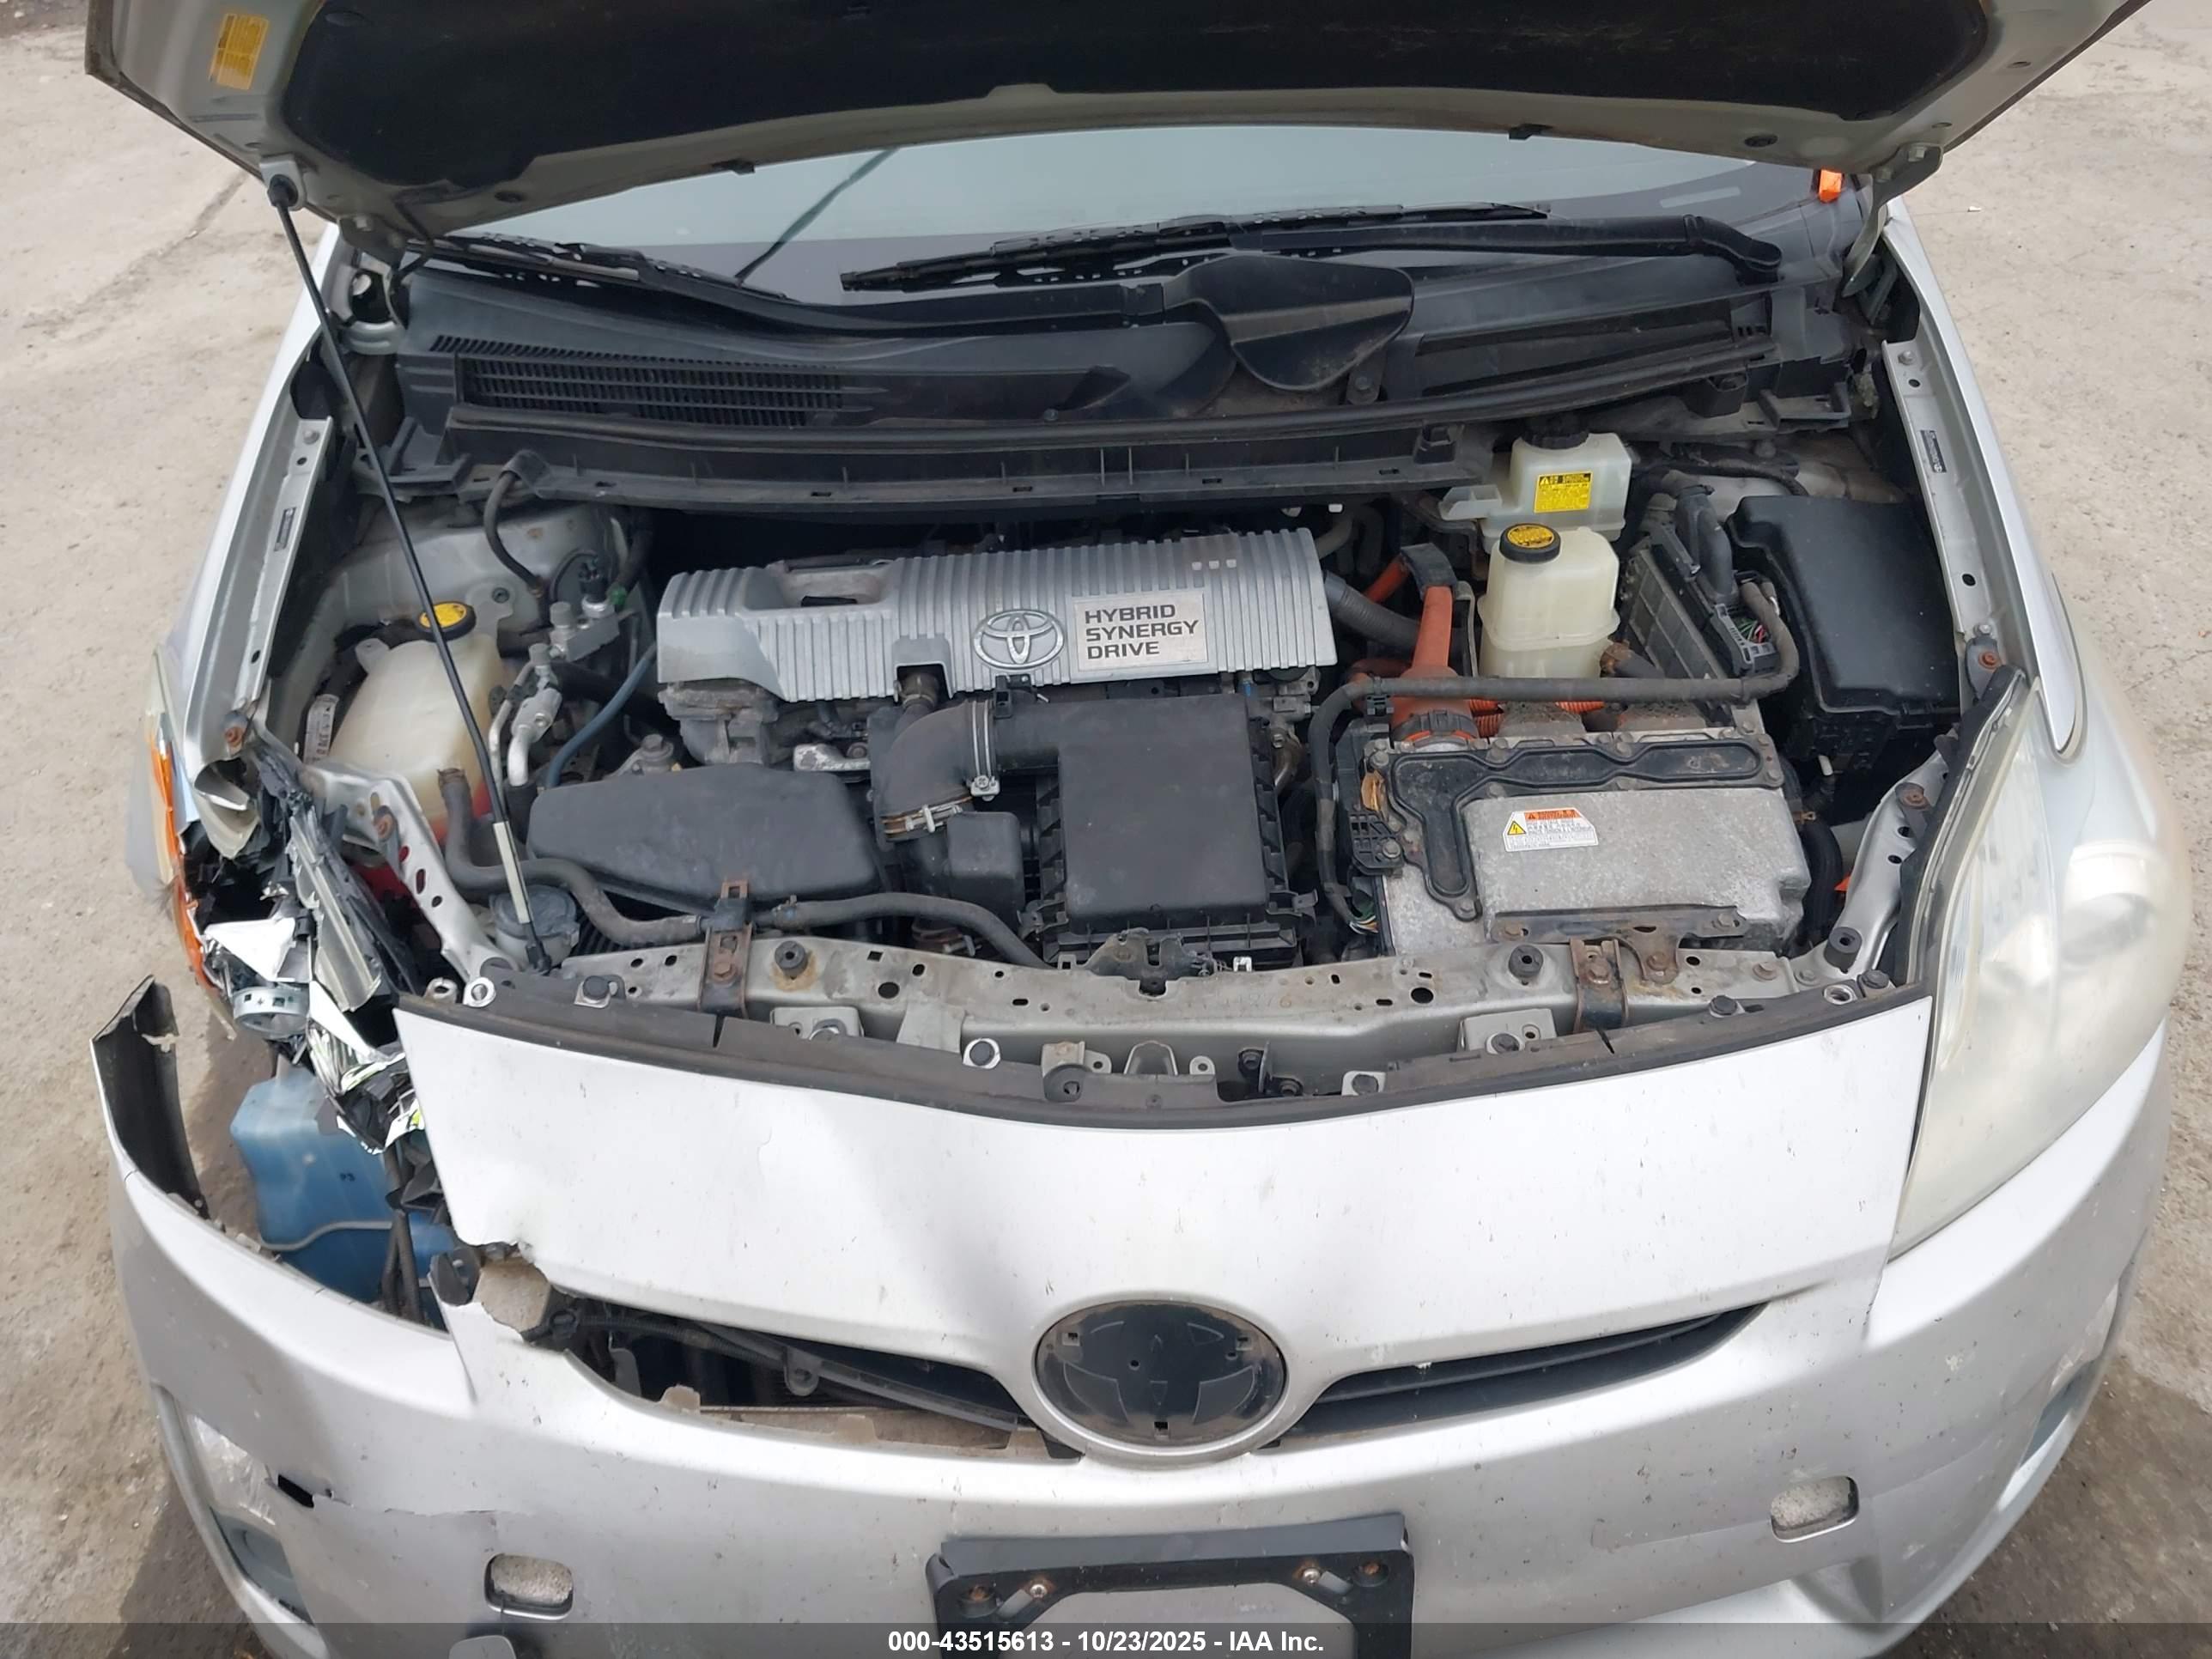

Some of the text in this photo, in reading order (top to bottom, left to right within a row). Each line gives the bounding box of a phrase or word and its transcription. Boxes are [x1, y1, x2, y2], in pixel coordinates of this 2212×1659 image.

[1085, 604, 1176, 623] HYBRID
[1085, 620, 1199, 641] SYNERGY
[1087, 641, 1159, 659] DRIVE
